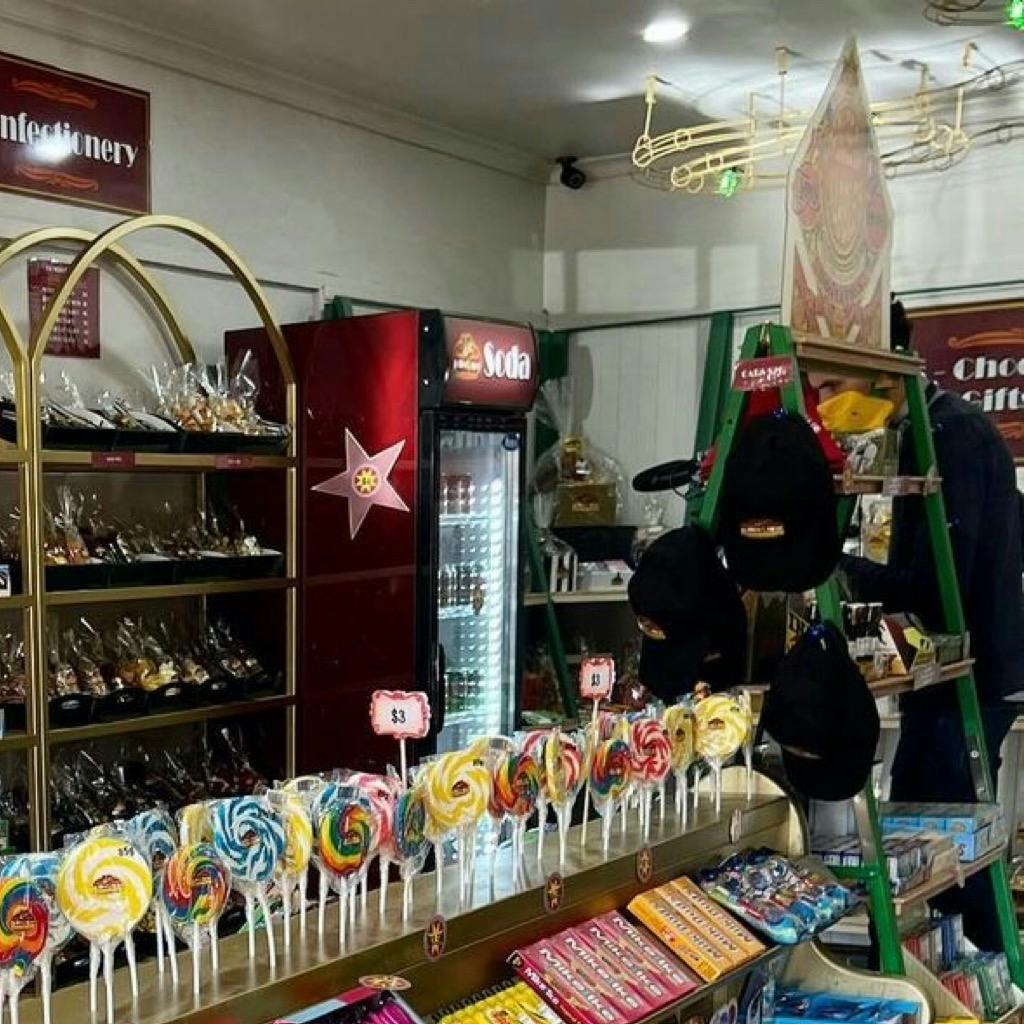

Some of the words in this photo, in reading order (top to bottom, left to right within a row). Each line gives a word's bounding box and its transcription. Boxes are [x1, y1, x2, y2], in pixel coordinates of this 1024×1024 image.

[483, 341, 531, 380] Soda
[962, 387, 1024, 412] Gift
[391, 707, 406, 724] $3
